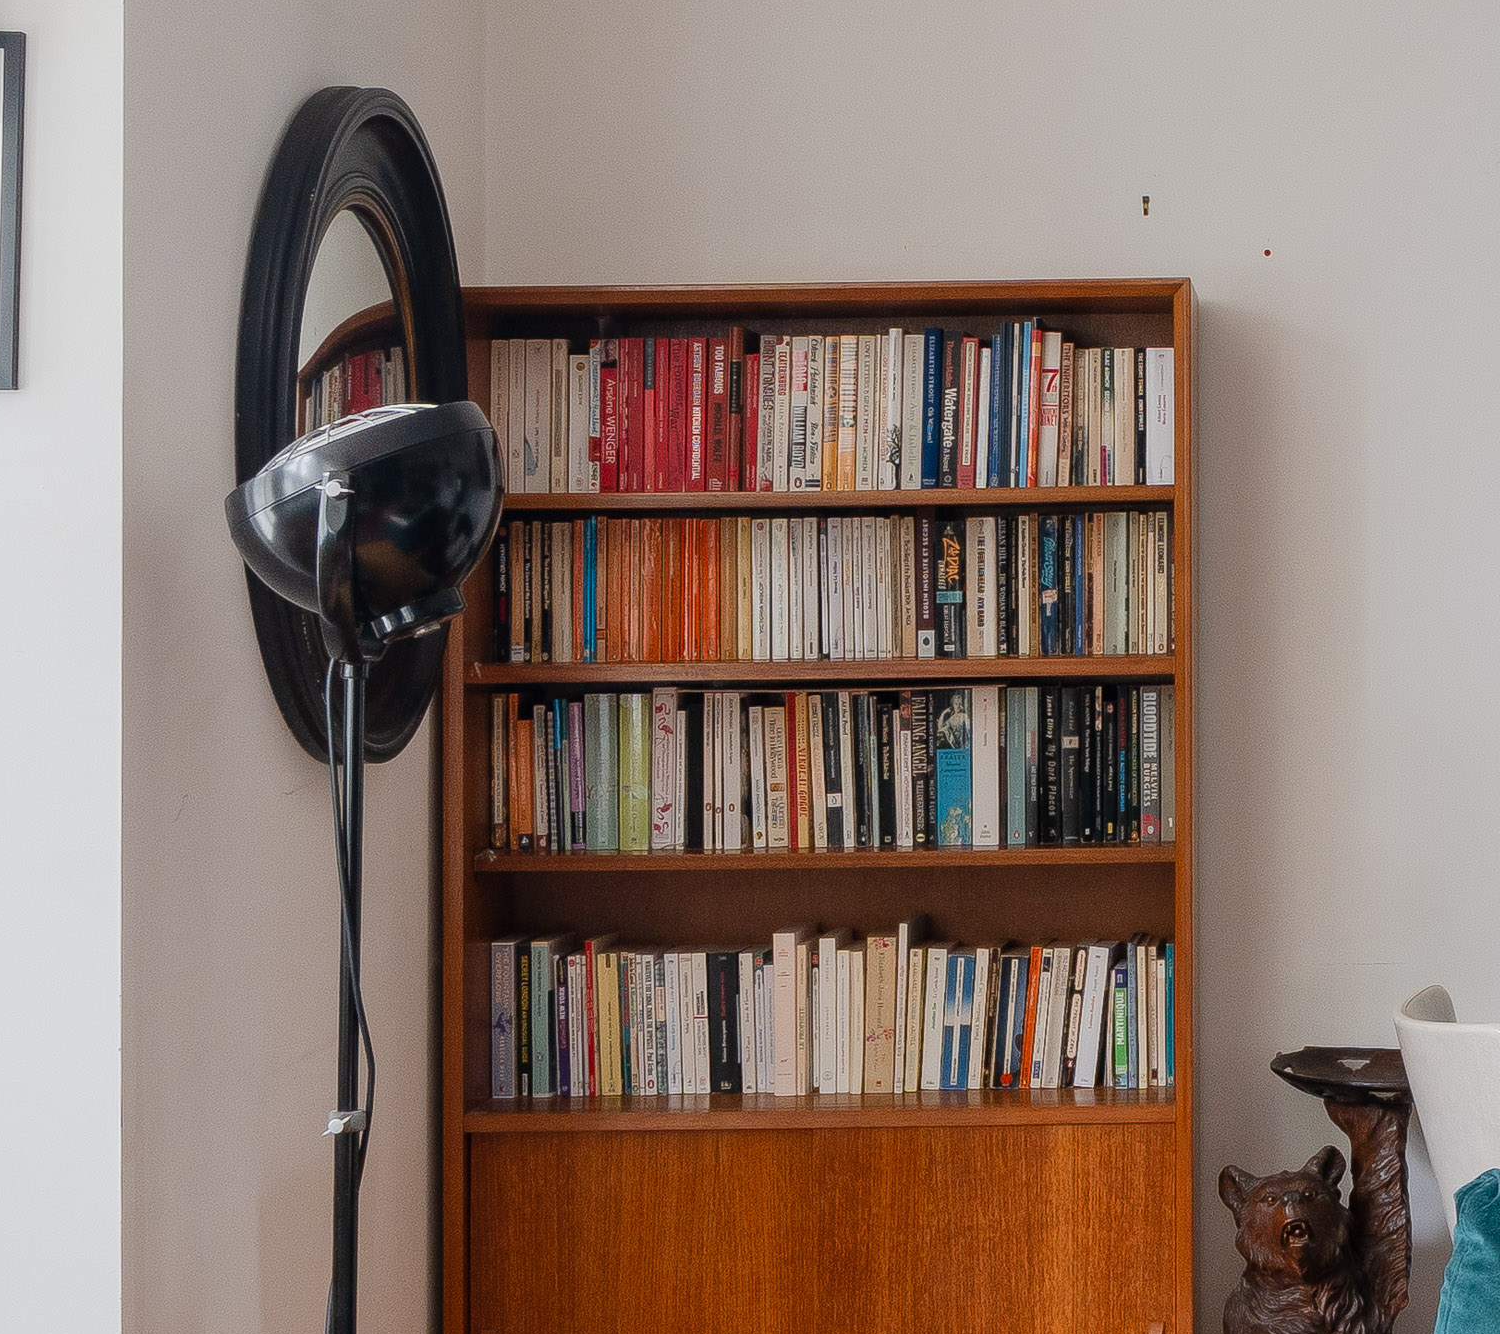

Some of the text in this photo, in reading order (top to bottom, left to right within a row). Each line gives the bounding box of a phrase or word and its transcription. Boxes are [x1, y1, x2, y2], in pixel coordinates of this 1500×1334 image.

[693, 342, 702, 371] ANTHONY
[714, 345, 724, 394] TOO FAMOUS
[946, 341, 954, 367] Thomas
[762, 371, 775, 410] TONGUES
[1062, 345, 1071, 414] THE INHERITORS
[605, 378, 617, 464] Arsène WENGER
[692, 407, 701, 434] KITCHEN
[908, 403, 918, 422] Amy
[942, 388, 957, 448] Watergate
[793, 406, 806, 468] WILLIAM BOYD
[908, 434, 917, 466] Isabelle
[691, 436, 701, 480] CONFIDENTIAL
[942, 454, 950, 472] Novel
[923, 548, 928, 556] ET
[977, 536, 985, 547] THE
[942, 536, 960, 584] ZODIAC
[977, 610, 985, 627] RAND
[912, 697, 927, 776] FALLING ANGEL
[1143, 692, 1157, 758] BLOODTIDE
[1046, 744, 1055, 756] My
[797, 748, 807, 817] NIKOLAI GOGOL
[1048, 761, 1056, 781] Dark
[877, 952, 885, 984] Elizabeth
[1117, 992, 1126, 1045] MARTINIQUE
